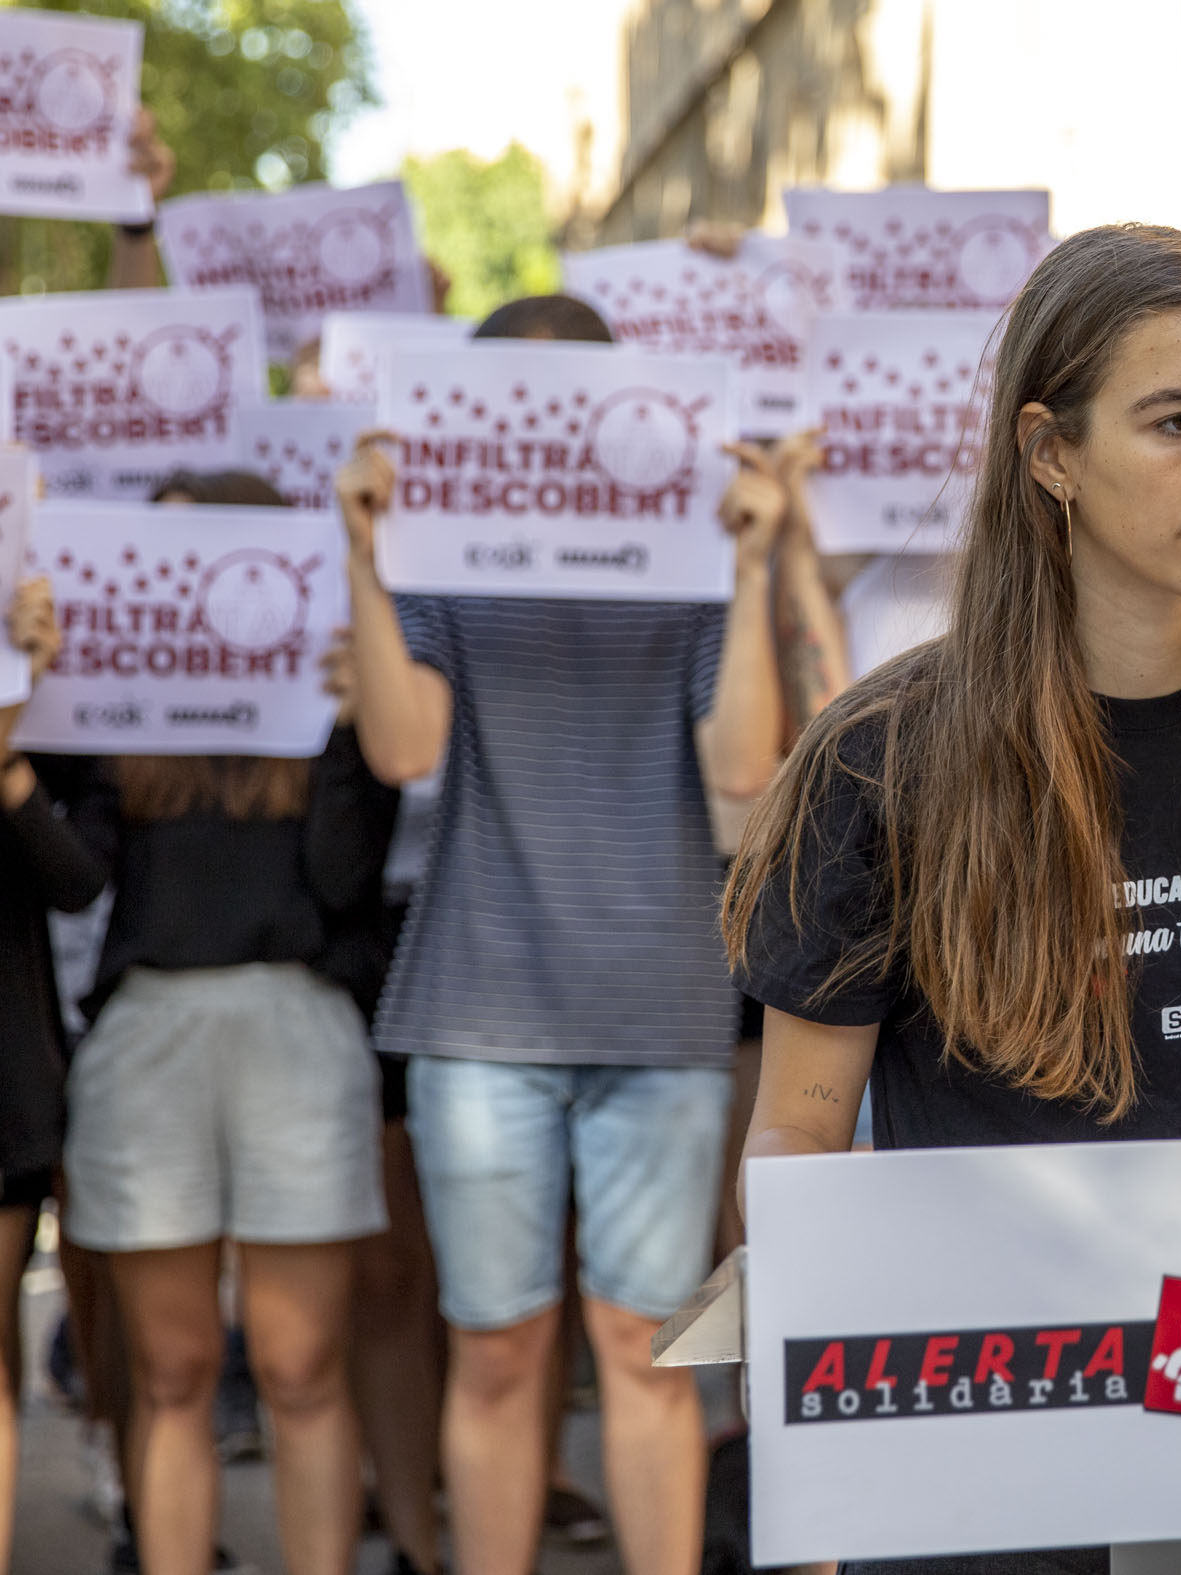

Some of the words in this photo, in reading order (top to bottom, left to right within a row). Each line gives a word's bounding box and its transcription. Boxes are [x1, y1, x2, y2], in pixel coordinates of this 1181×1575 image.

[401, 478, 692, 521] DESCOBERT
[803, 1327, 1125, 1392] ALERTA
[801, 1370, 1129, 1418] solidària
